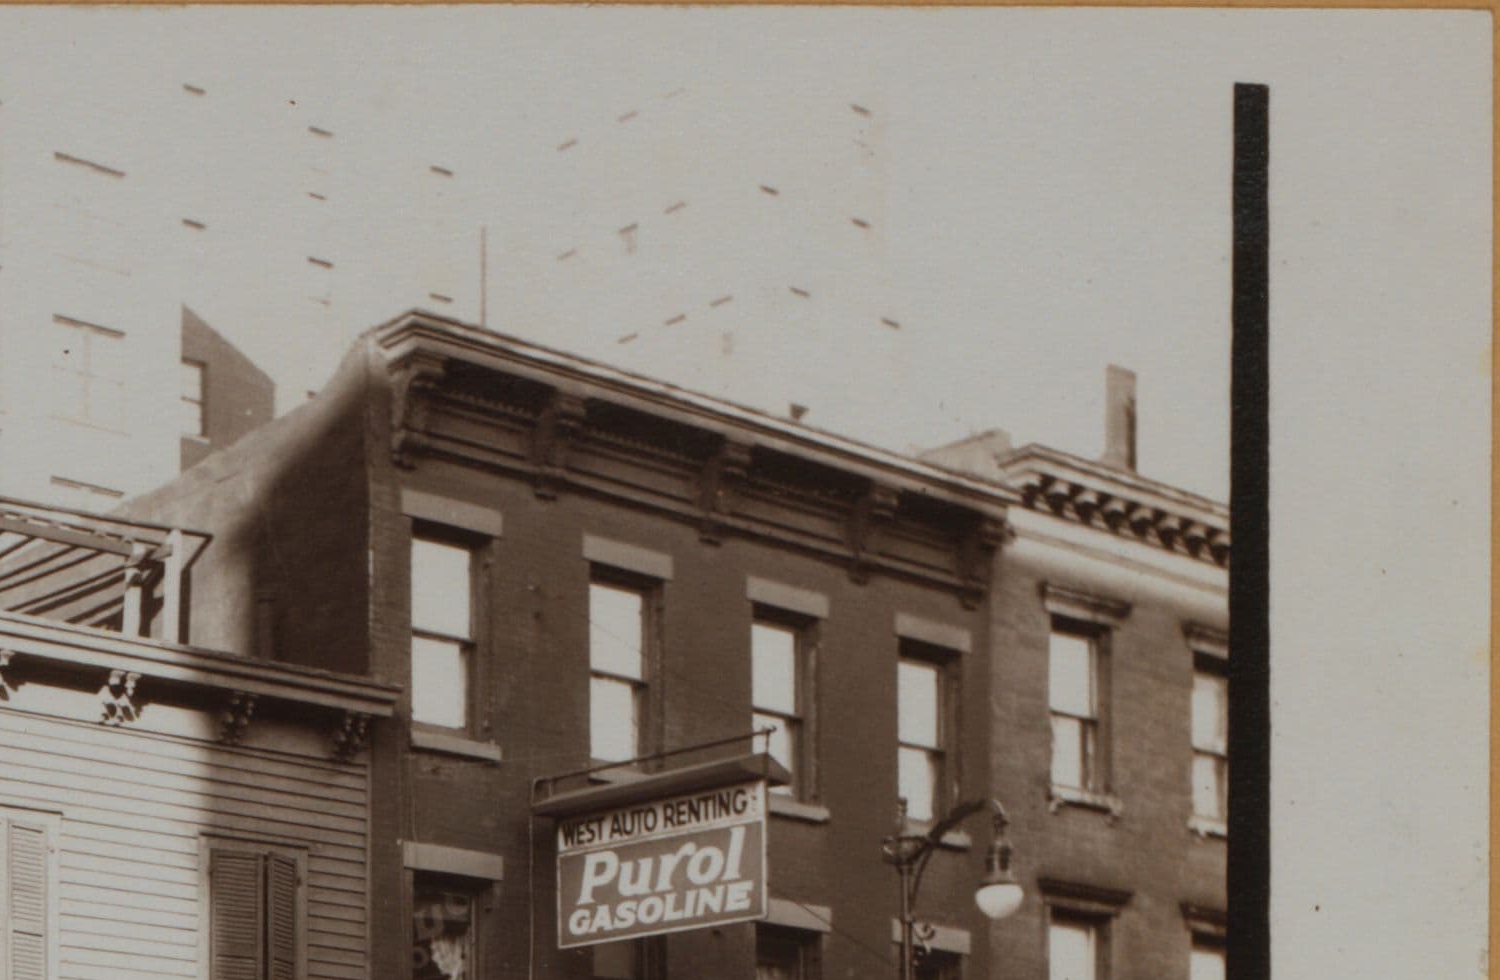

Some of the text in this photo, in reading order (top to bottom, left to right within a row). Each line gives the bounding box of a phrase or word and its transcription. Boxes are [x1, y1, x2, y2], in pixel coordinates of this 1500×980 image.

[563, 816, 604, 847] WEST
[609, 806, 658, 840] AUTO
[662, 789, 748, 829] RENTING
[576, 826, 746, 906] Purol
[568, 880, 755, 936] GASOLINE
